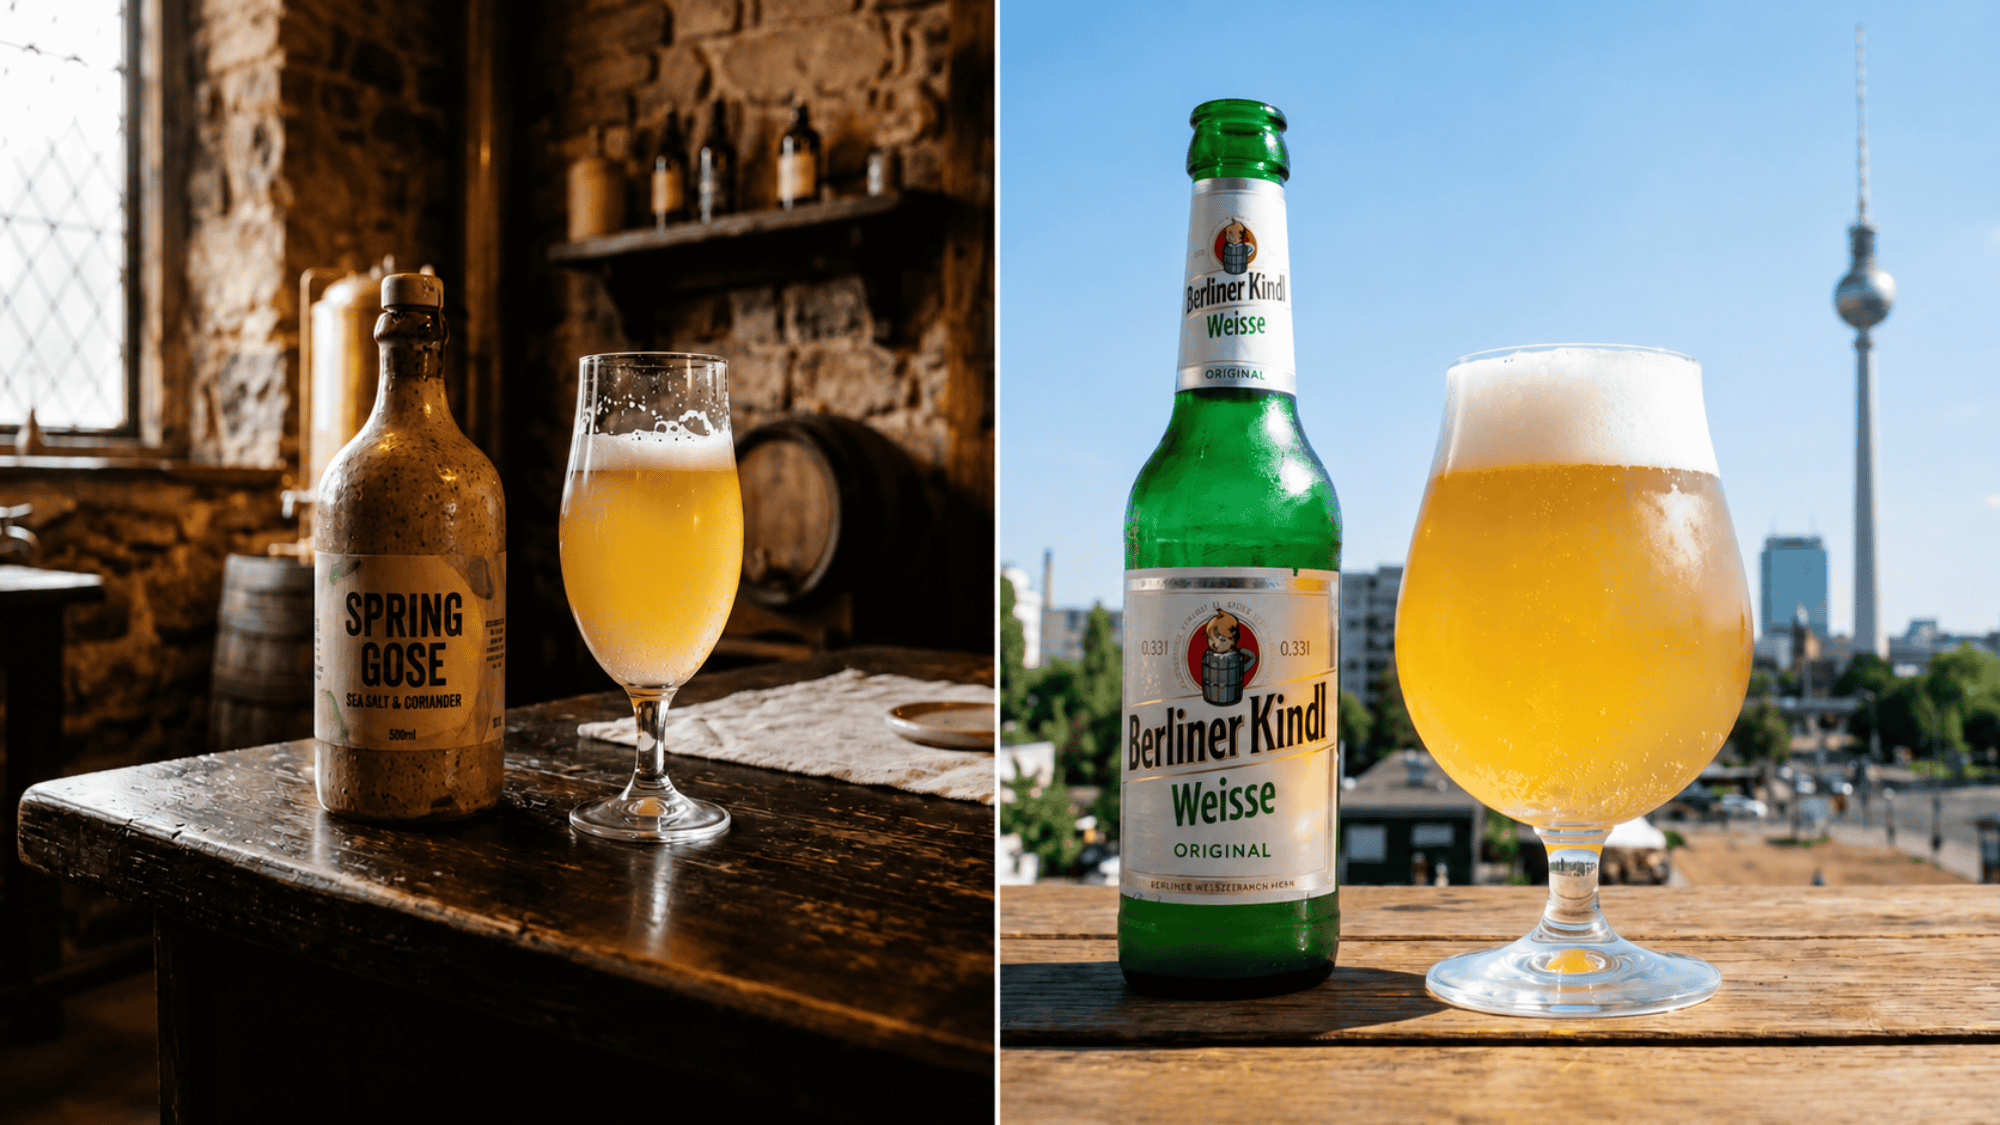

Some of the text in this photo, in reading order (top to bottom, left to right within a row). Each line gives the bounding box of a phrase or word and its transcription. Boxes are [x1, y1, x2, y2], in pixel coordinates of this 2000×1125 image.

[1186, 272, 1286, 314] Berliner Kindl
[1206, 310, 1266, 339] Weisse
[1205, 368, 1266, 380] ORIGINAL
[345, 592, 463, 638] SPRING
[361, 642, 447, 688] GOSE
[346, 692, 462, 710] SEA SALT & CORIANDER
[389, 728, 416, 741] 500ml
[1128, 681, 1327, 772] Berliner Kindl
[1171, 776, 1276, 827] Weisse
[1173, 842, 1272, 859] ORIGINAL
